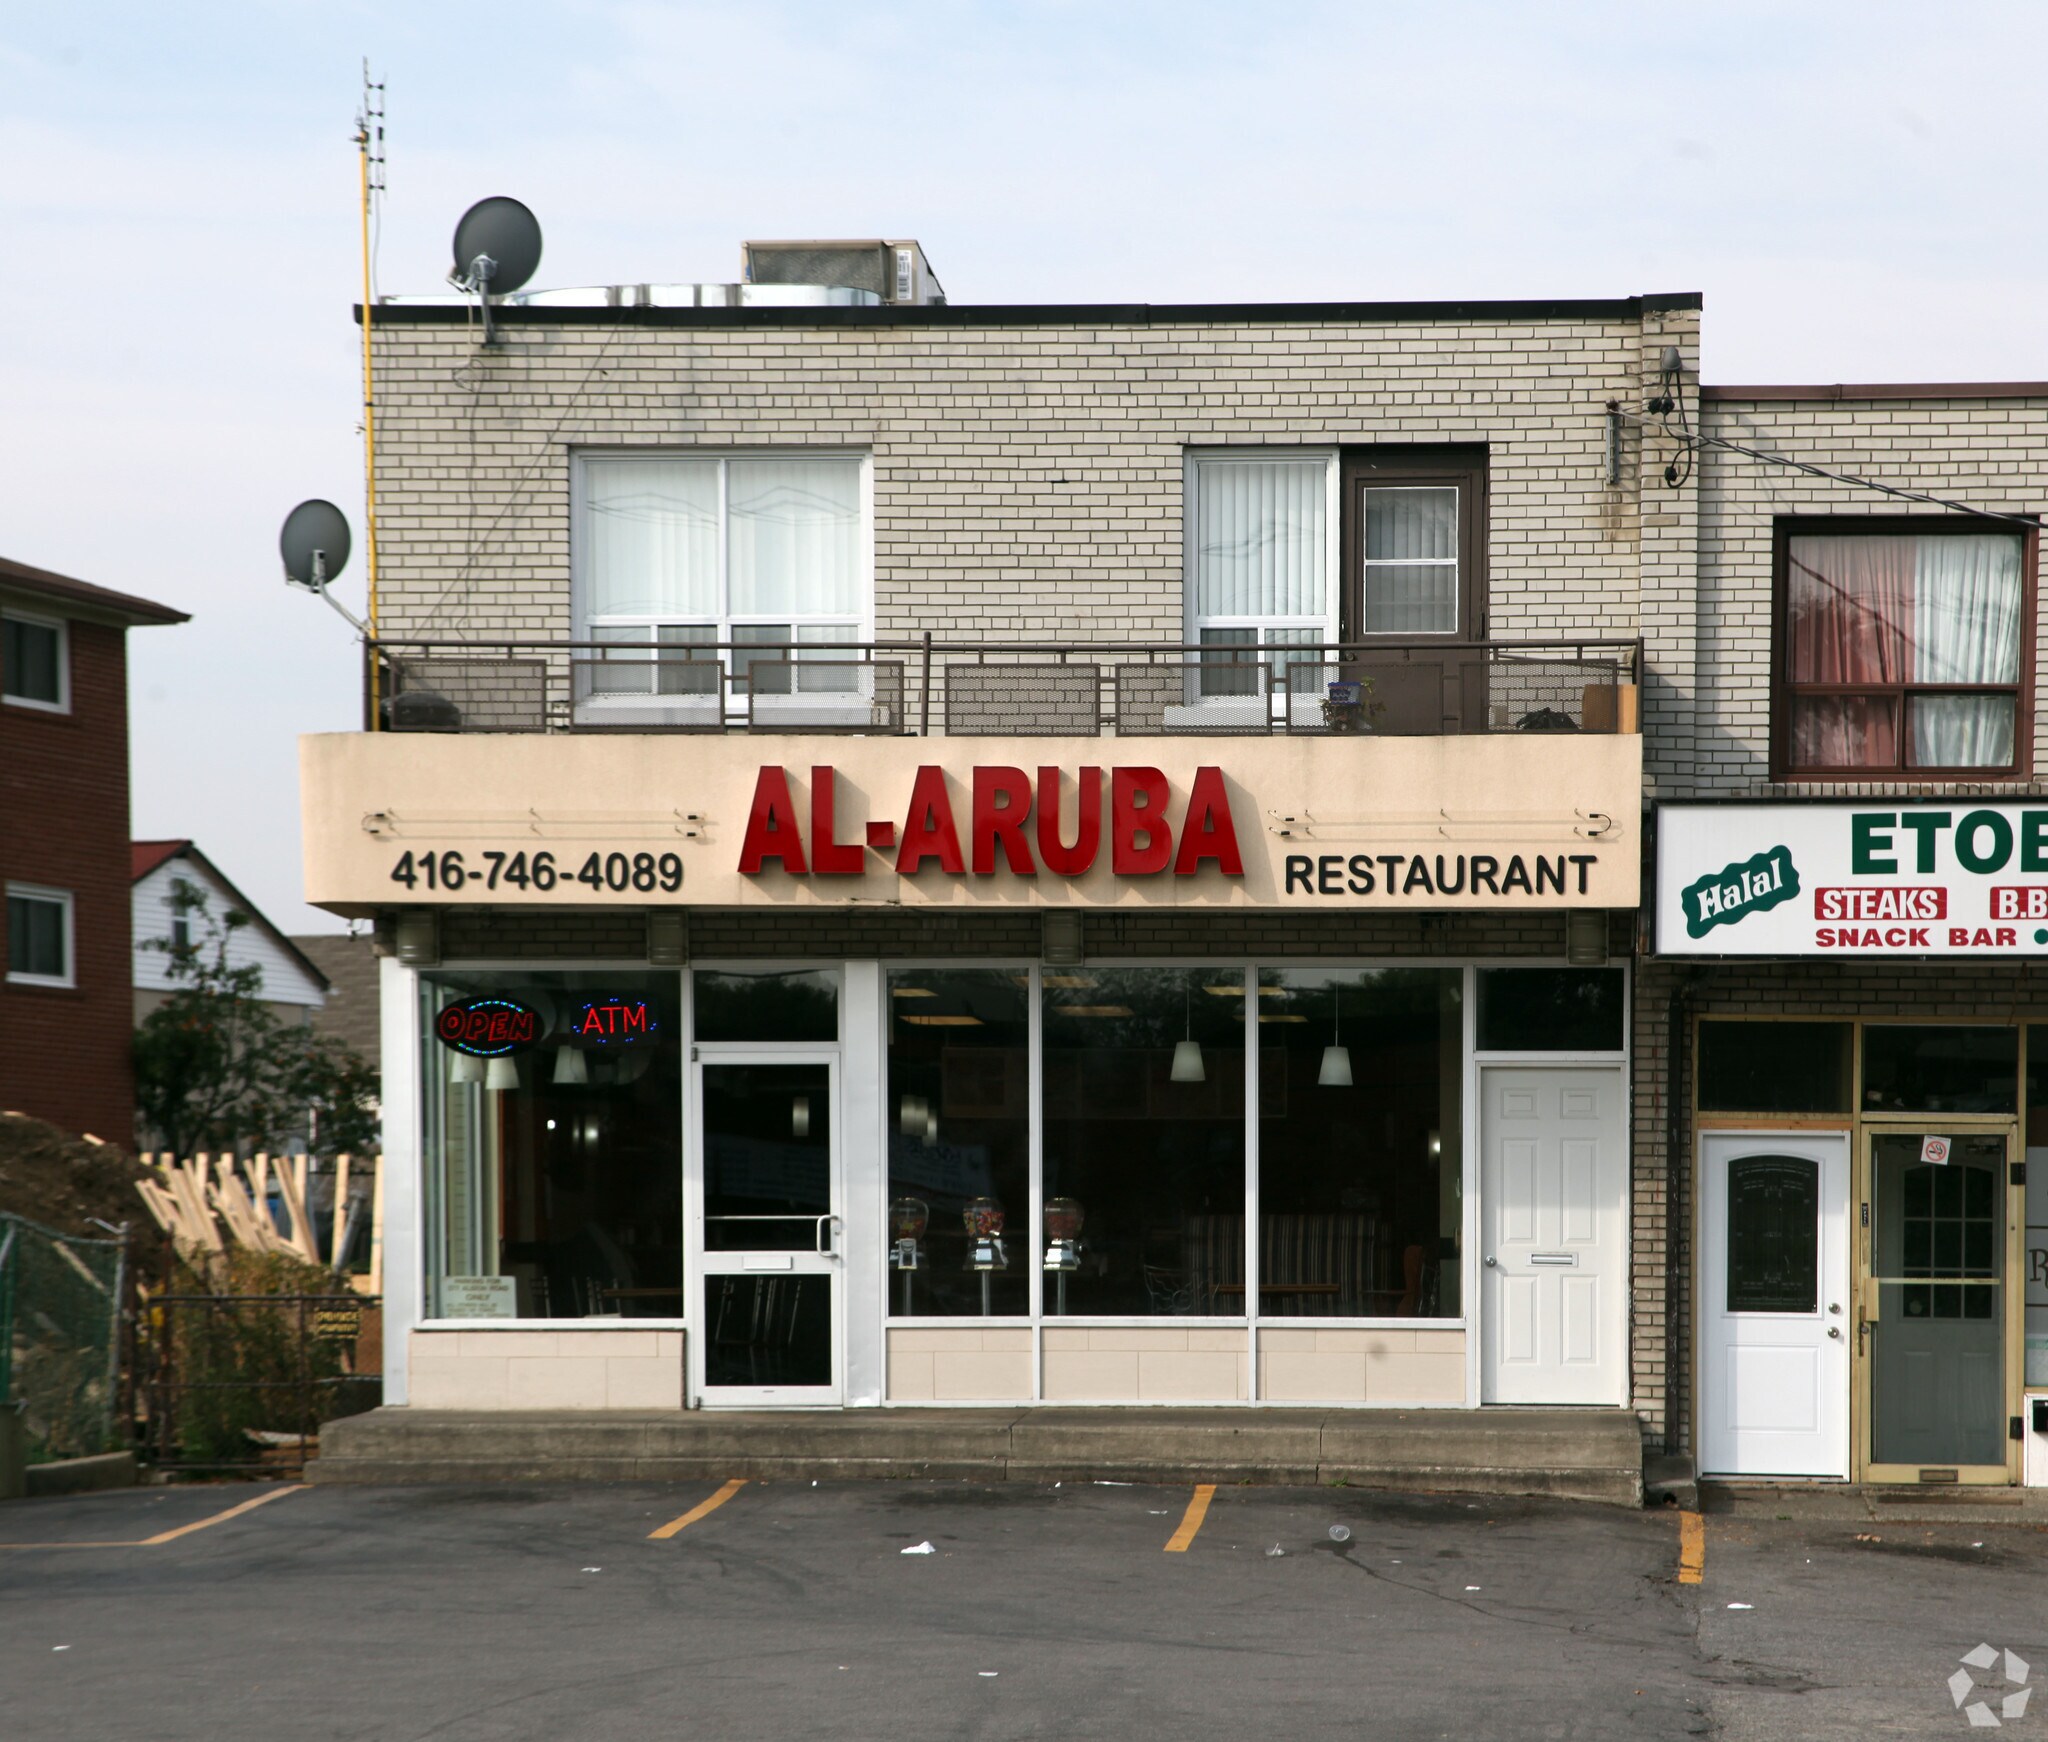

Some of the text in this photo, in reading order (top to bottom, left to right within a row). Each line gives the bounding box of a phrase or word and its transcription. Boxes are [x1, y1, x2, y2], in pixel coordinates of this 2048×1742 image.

[738, 765, 1244, 876] AL-ARUBA
[391, 851, 683, 892] 416-746-4089
[1285, 854, 1598, 895] RESTAURANT
[1696, 857, 1783, 922] Halal
[1822, 889, 1938, 919] STEAKS
[1816, 927, 2017, 947] SNACK BAR
[440, 1007, 534, 1042] OPEN
[583, 1006, 646, 1034] ATM
